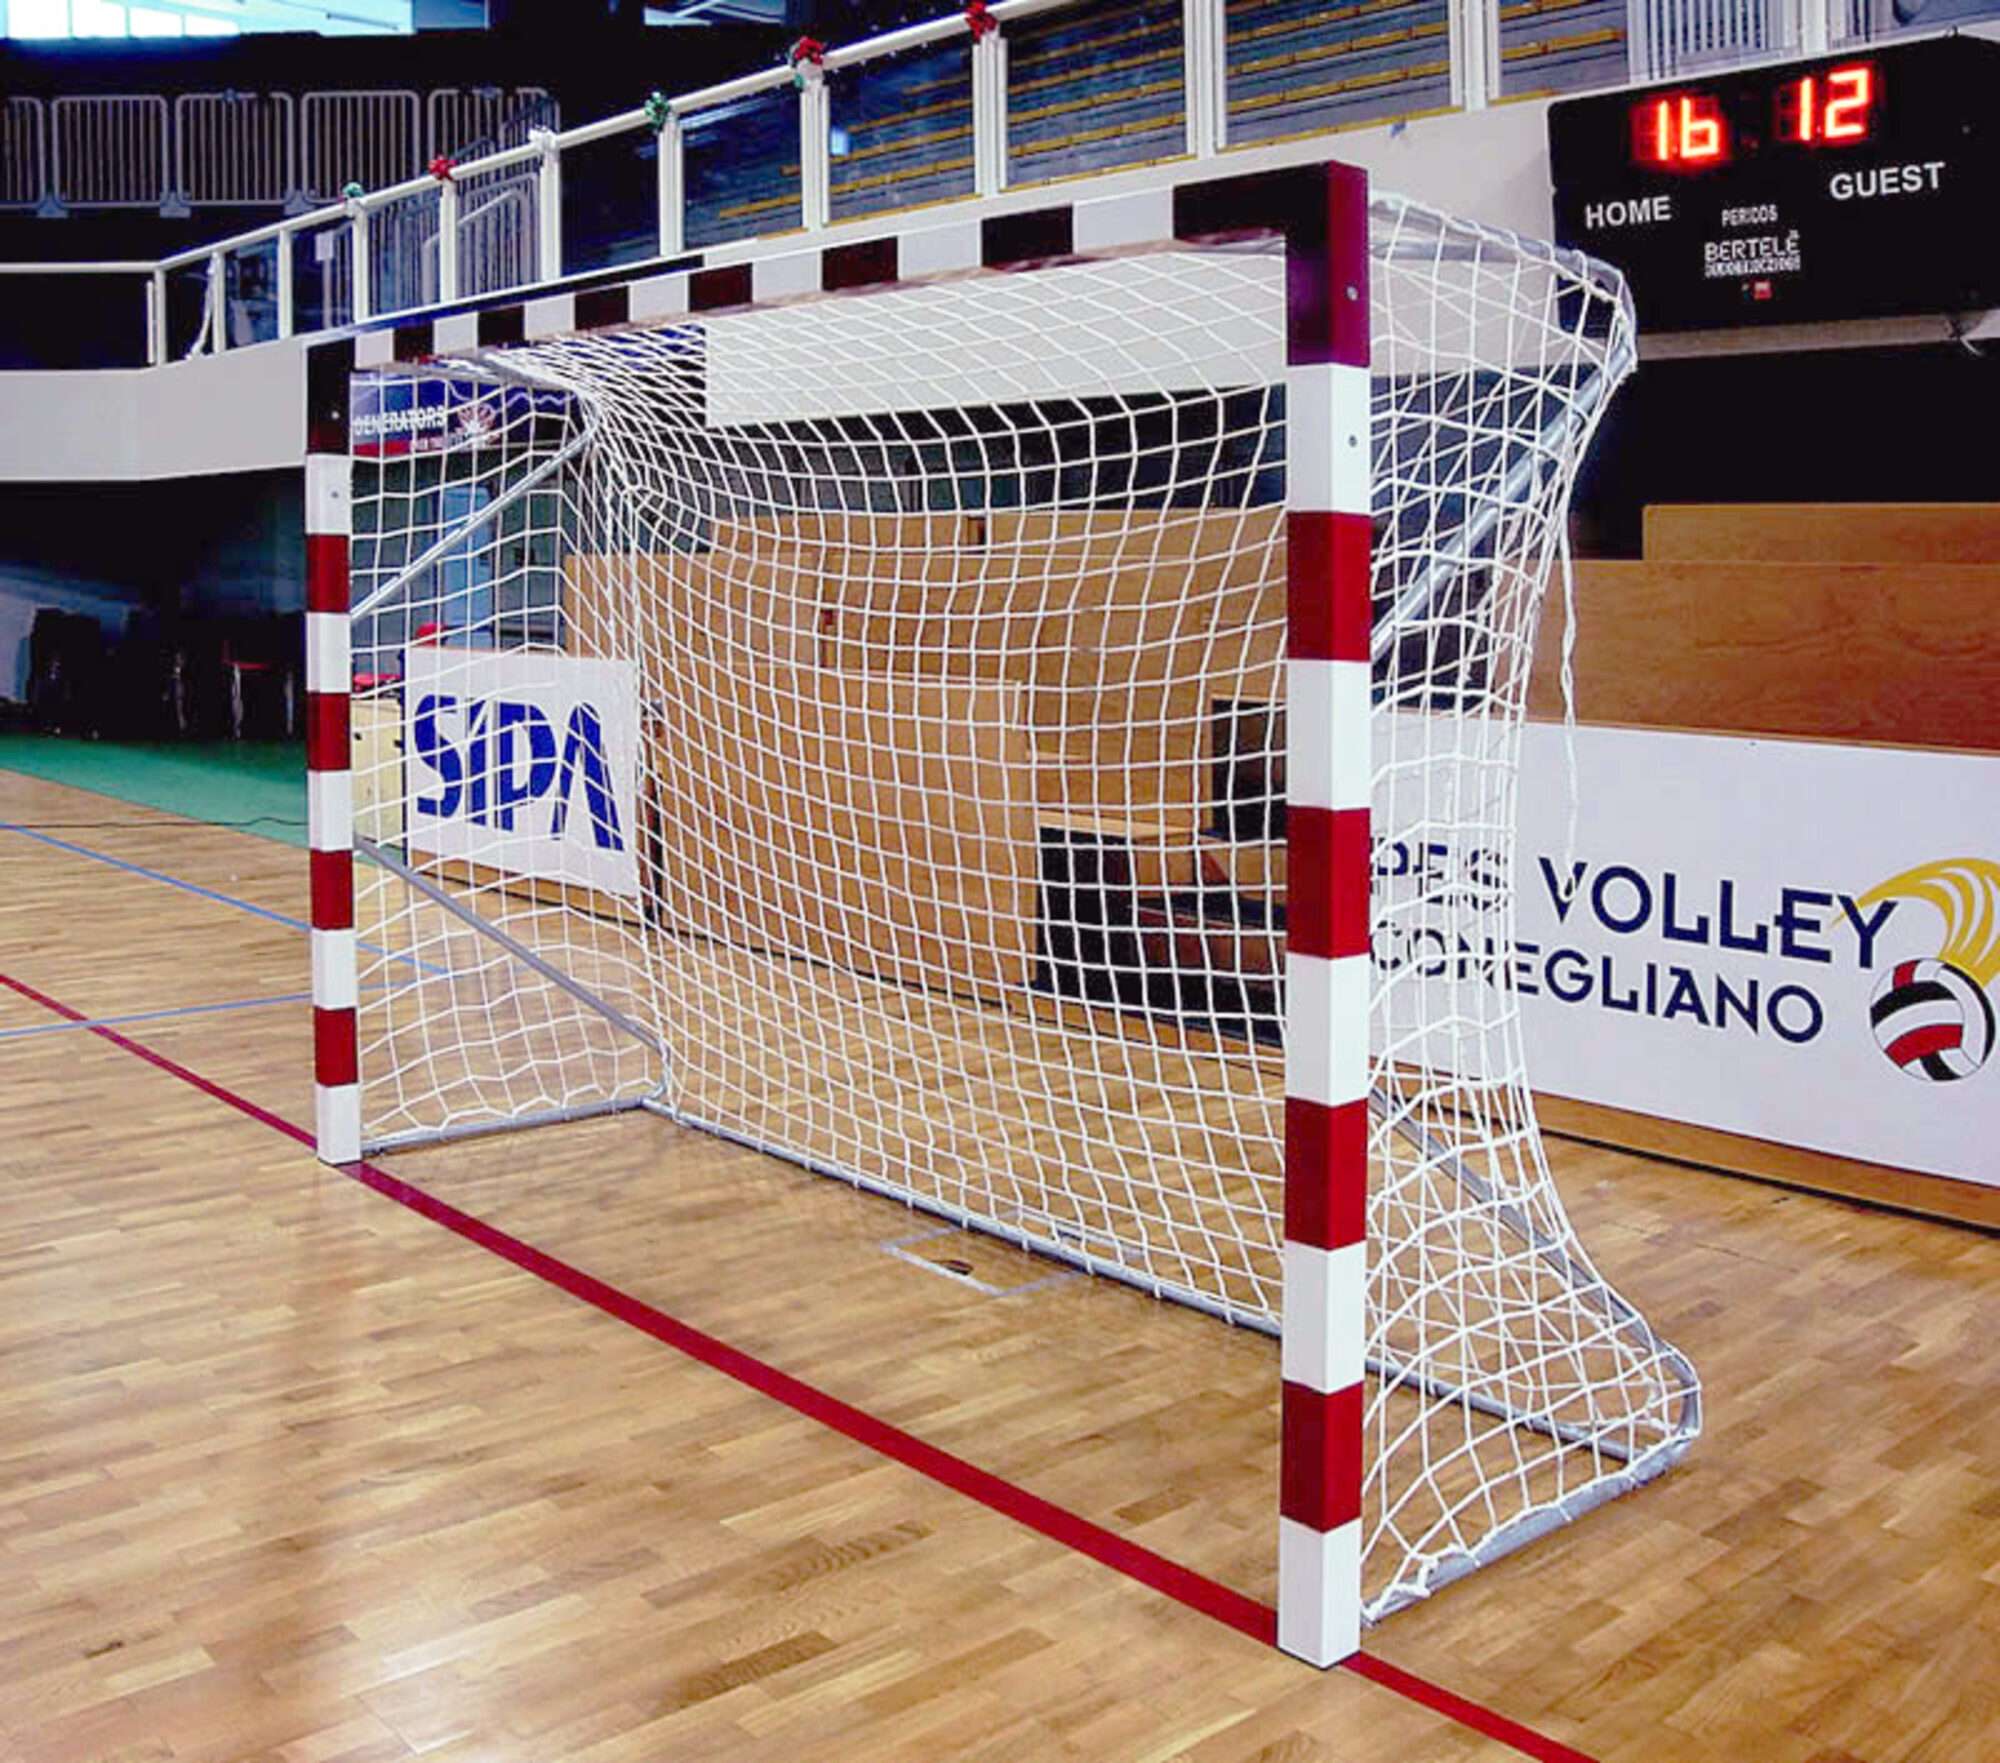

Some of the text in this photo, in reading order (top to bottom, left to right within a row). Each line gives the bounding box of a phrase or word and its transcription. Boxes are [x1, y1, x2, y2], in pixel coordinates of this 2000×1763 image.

[1656, 67, 1870, 161] 16 12
[1585, 160, 1947, 229] HOME GUEST
[413, 693, 626, 852] SIPA
[1538, 856, 1899, 970] VOLLEY
[1370, 919, 1824, 1044] CONEGLIANO
